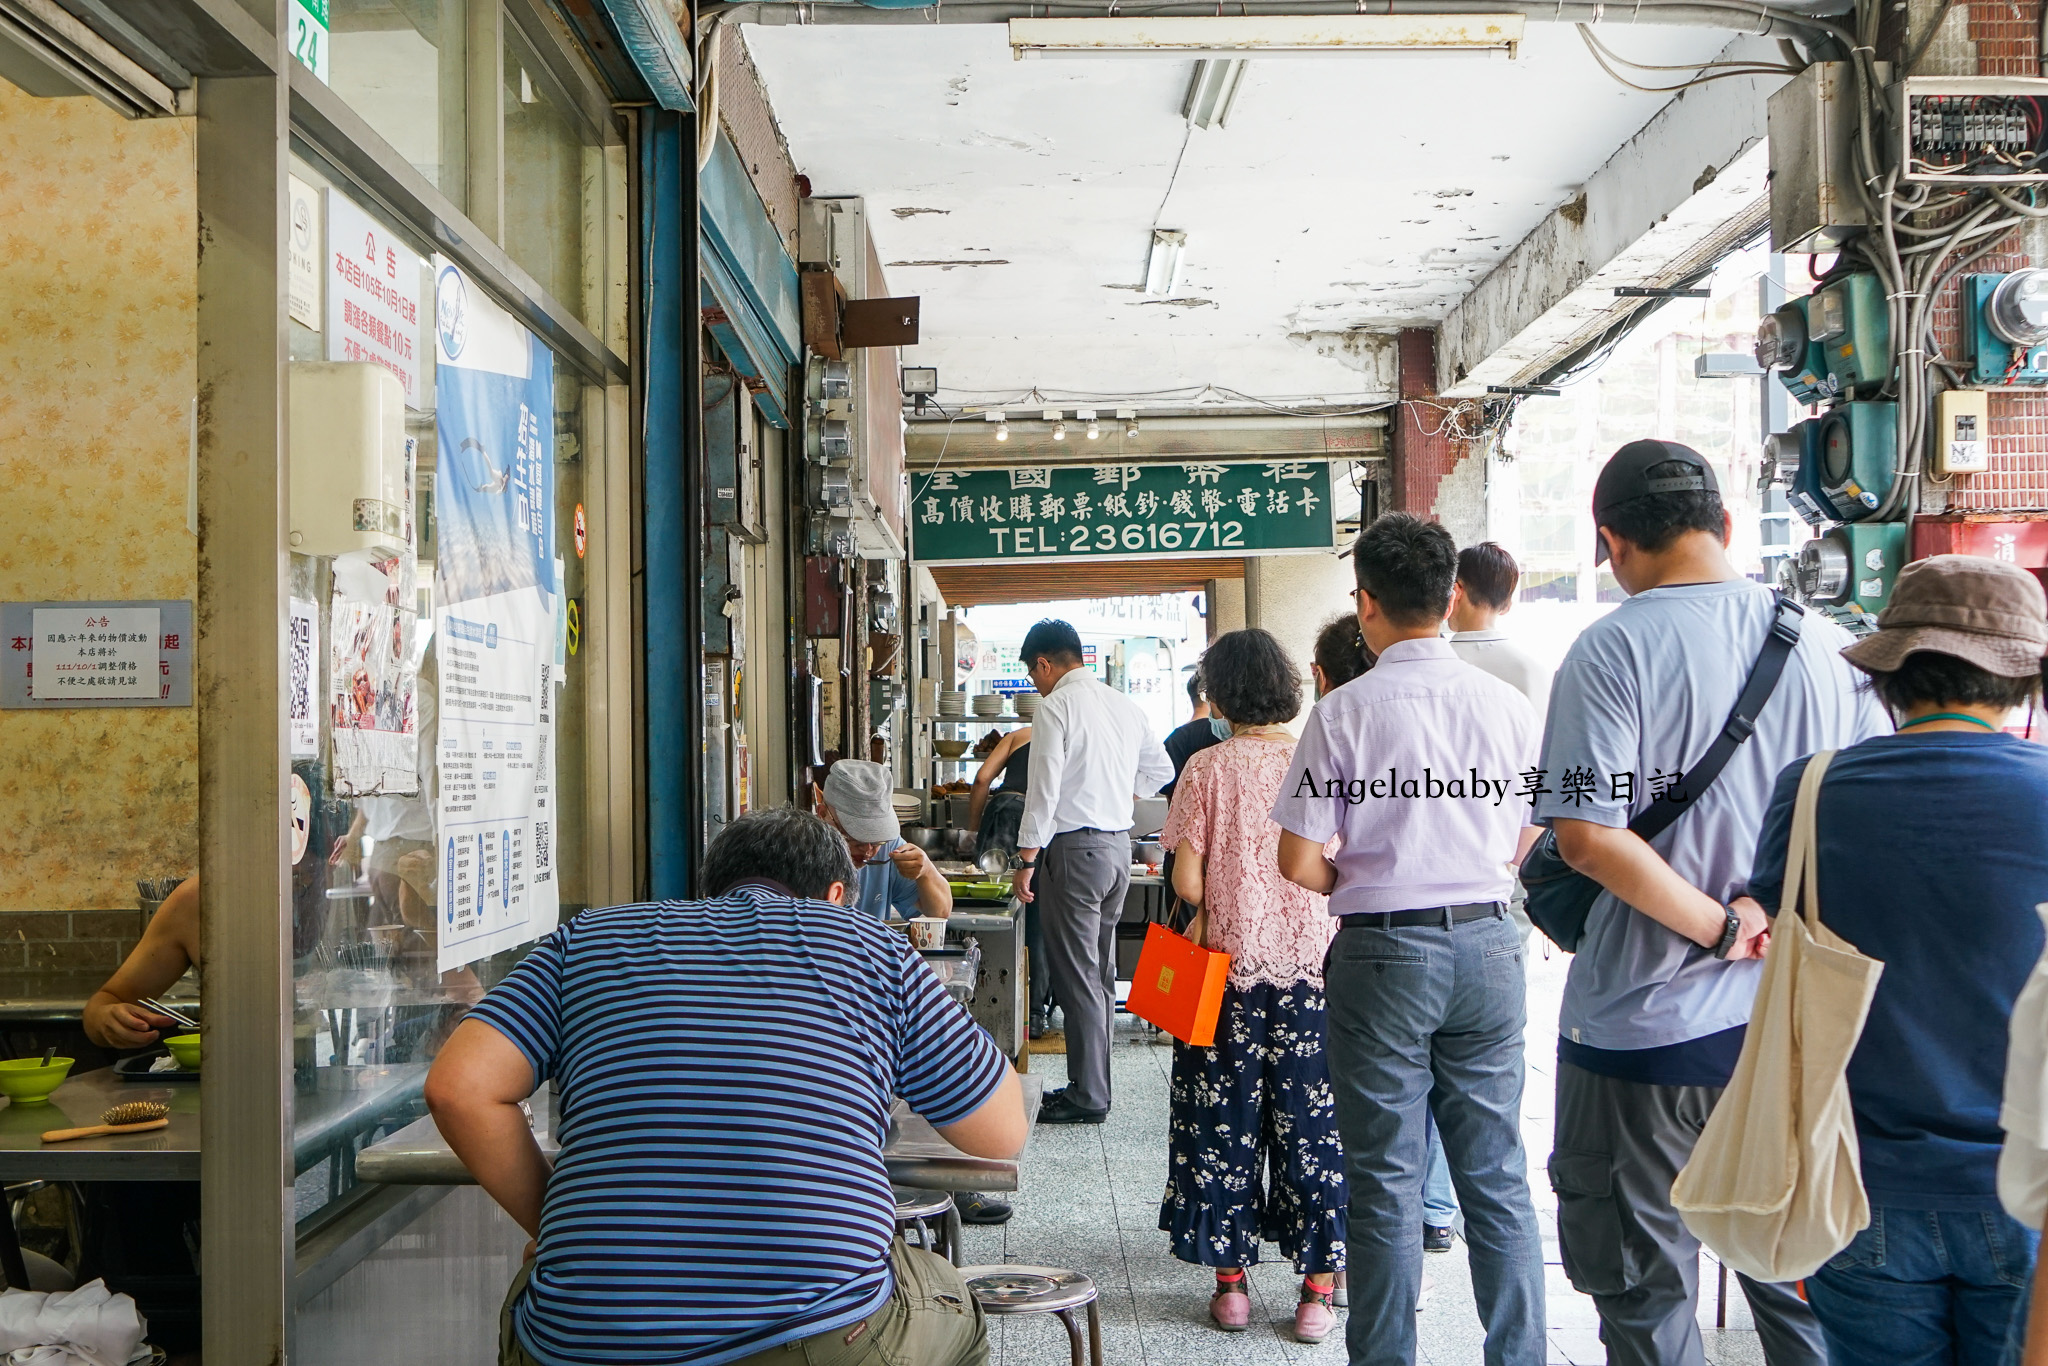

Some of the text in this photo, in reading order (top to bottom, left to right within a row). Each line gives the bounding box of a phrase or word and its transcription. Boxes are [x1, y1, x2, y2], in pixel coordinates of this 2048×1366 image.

[296, 18, 317, 74] 24
[336, 251, 416, 325] 本店自105年10月1日起
[989, 520, 1245, 554] TEL:23616712
[85, 615, 110, 628] 公告
[47, 633, 148, 643] 因應六年來的物價波動
[77, 647, 117, 657] 本店將於
[57, 676, 137, 686] 不便之處敬請見諒
